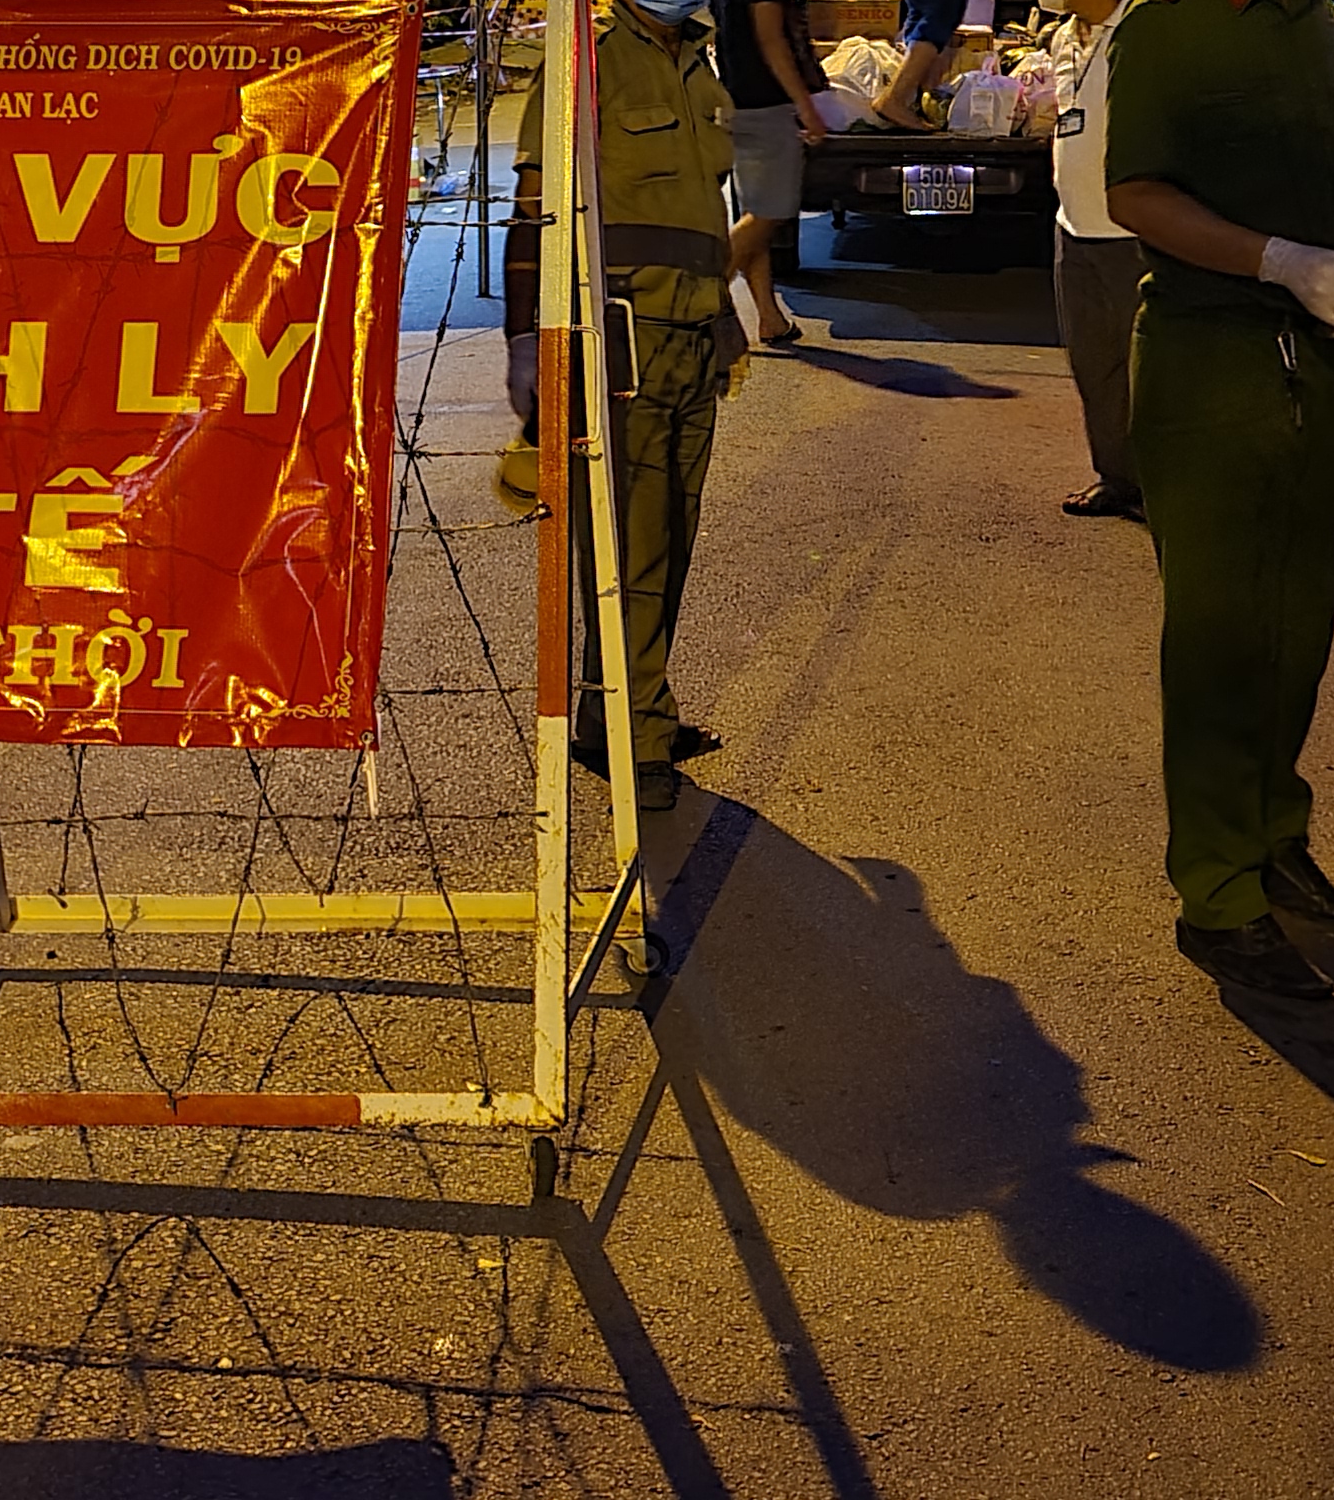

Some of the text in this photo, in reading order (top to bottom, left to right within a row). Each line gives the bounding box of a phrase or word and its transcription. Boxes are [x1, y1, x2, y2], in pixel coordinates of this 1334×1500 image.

[837, 8, 895, 20] SENKO
[86, 45, 162, 76] DỊCH
[169, 45, 303, 71] COVID-19
[42, 92, 100, 125] LẠC
[920, 165, 956, 188] 50A
[13, 135, 345, 264] VỰC
[907, 187, 970, 210] 010.94
[116, 321, 317, 414] LY
